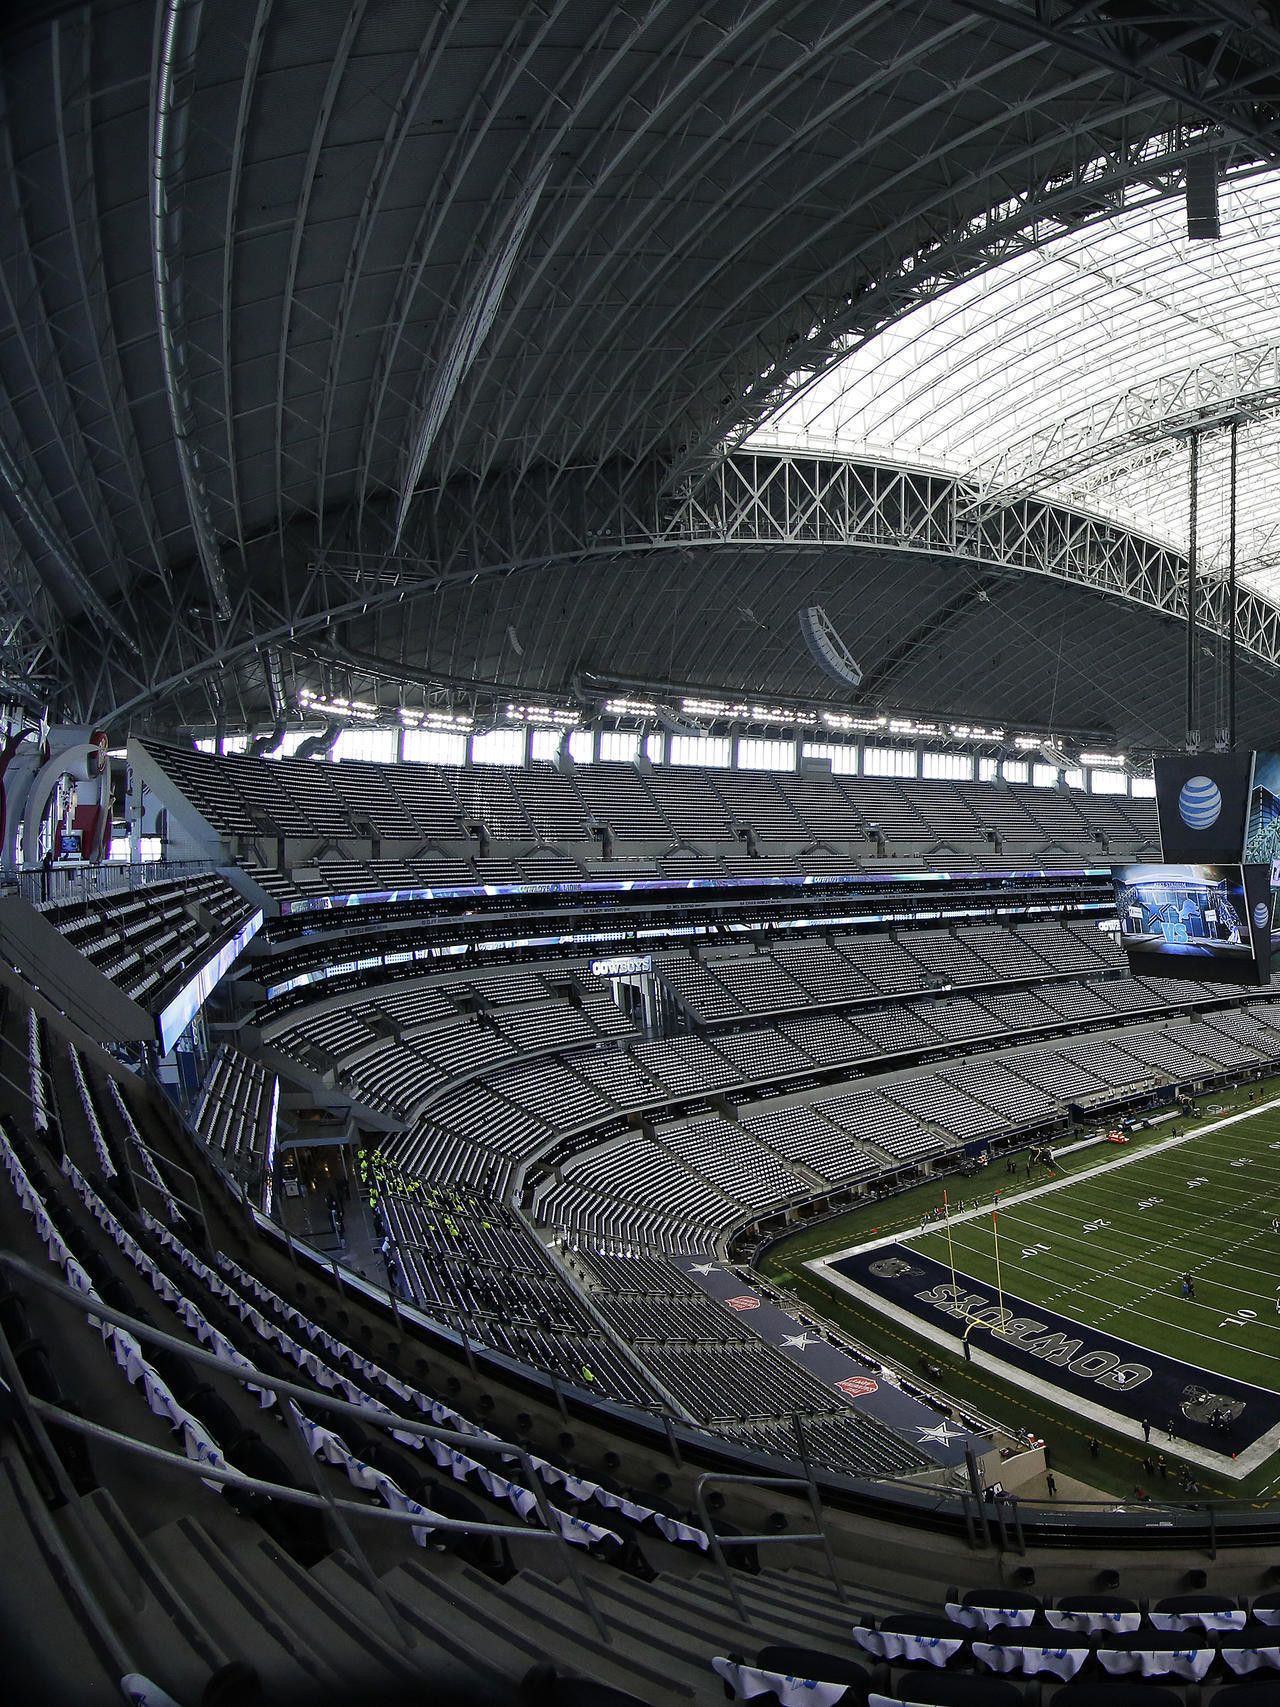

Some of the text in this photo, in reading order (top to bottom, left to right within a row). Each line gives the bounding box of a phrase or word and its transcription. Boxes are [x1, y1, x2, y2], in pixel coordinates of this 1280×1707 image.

[1161, 923, 1189, 942] VS
[592, 959, 651, 976] COWBOYS
[1083, 1218, 1112, 1231] 20
[1022, 1243, 1052, 1256] 10
[1224, 1309, 1258, 1327] 10
[914, 1284, 1153, 1391] COWBOYS
